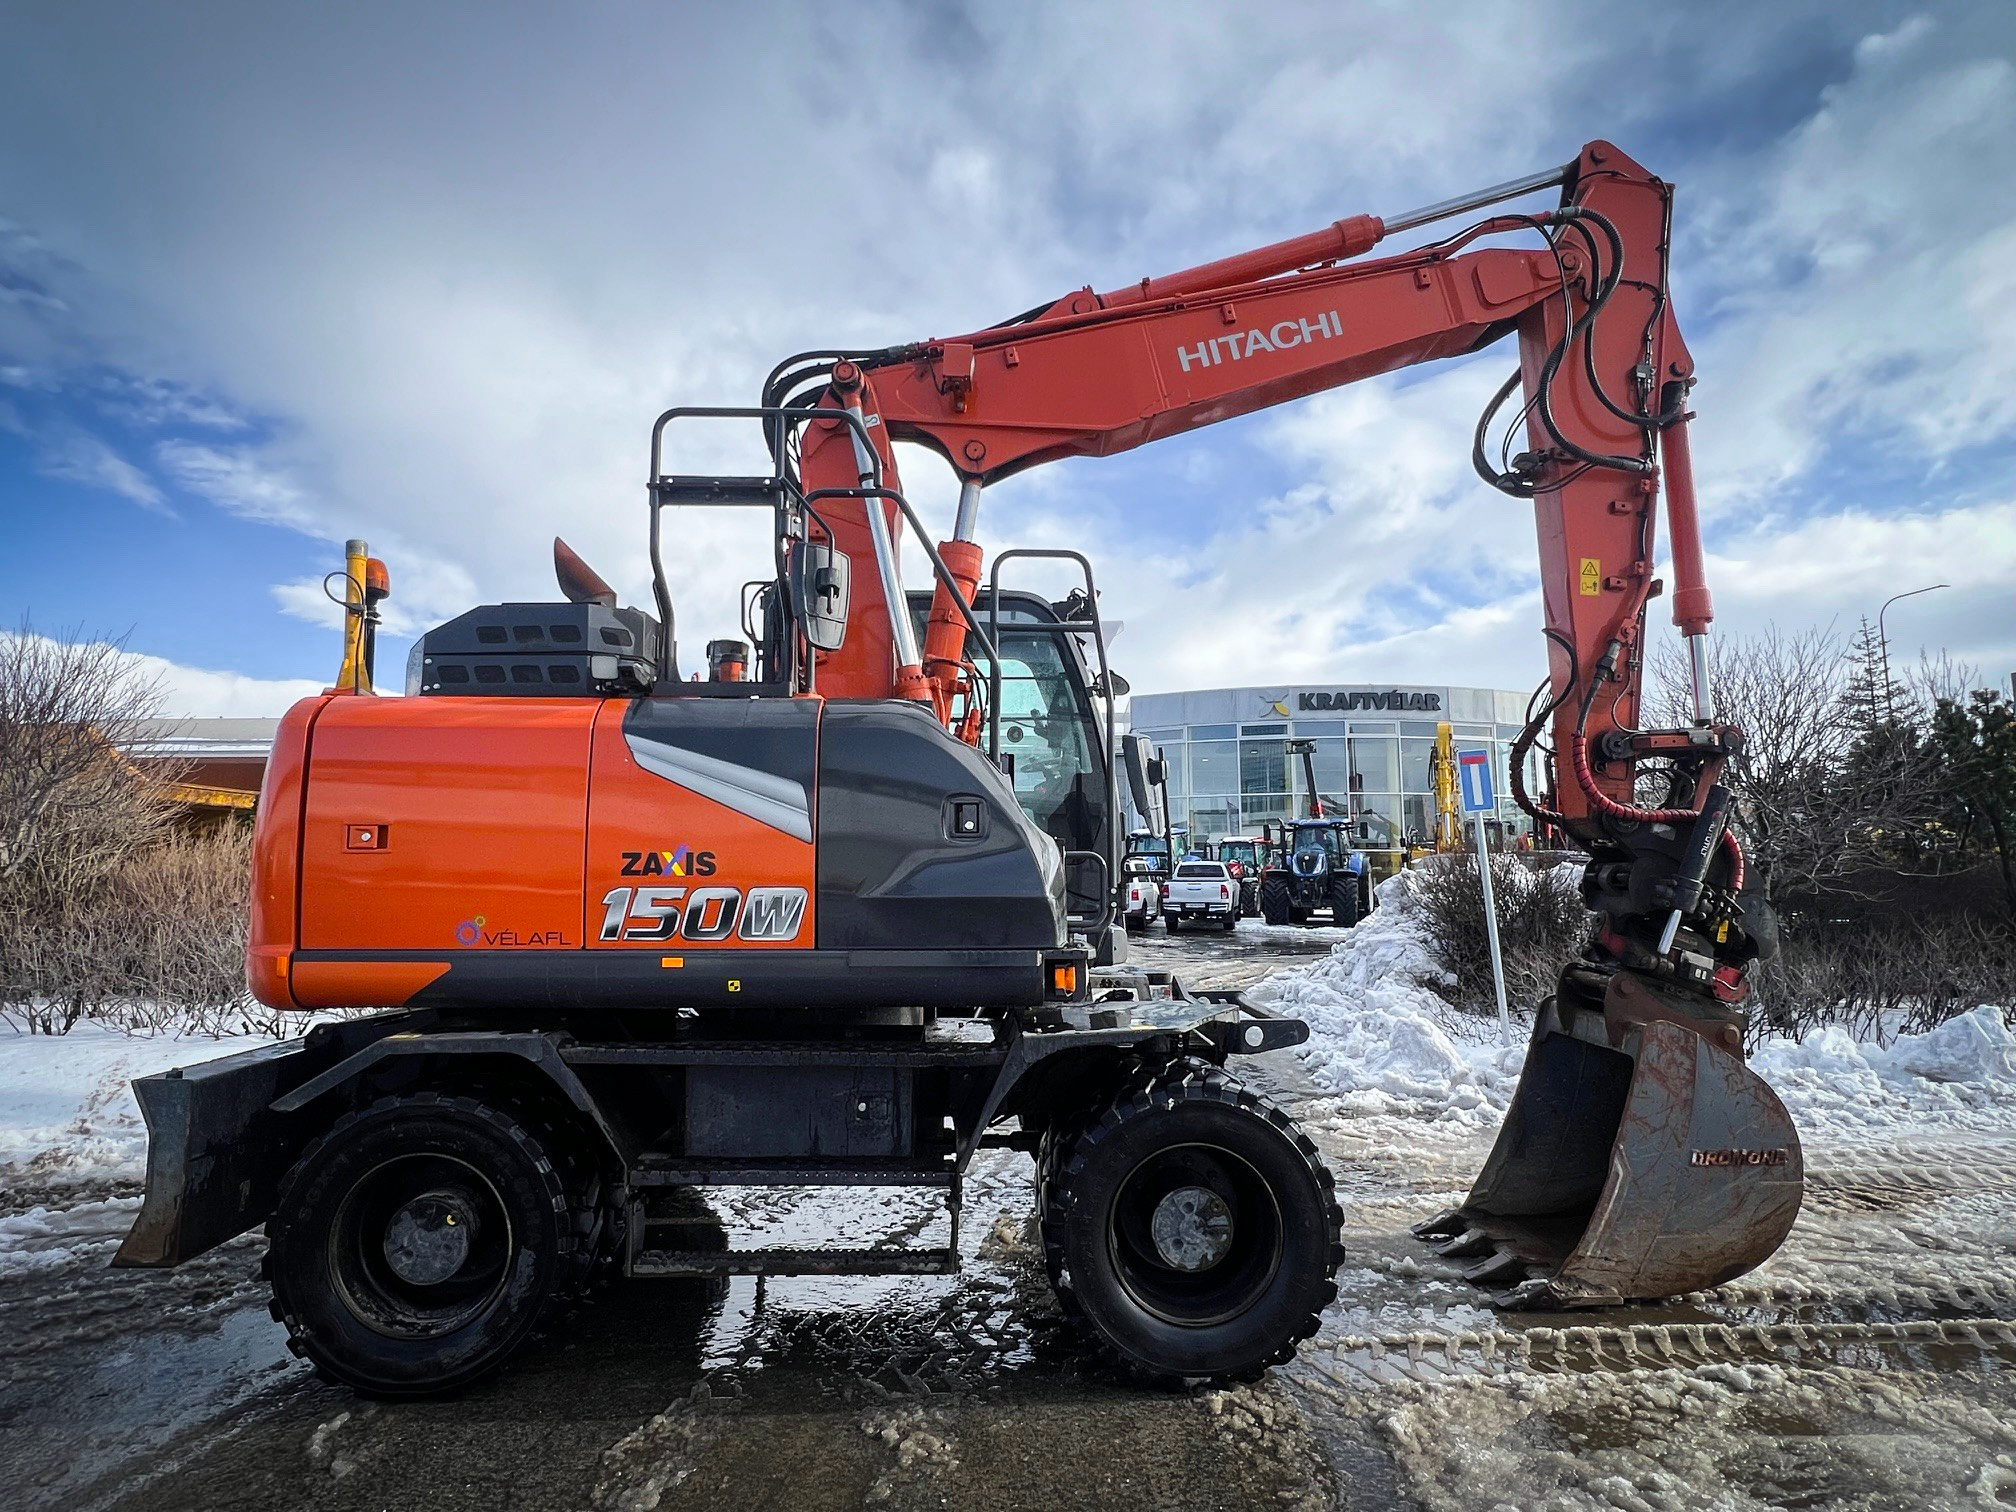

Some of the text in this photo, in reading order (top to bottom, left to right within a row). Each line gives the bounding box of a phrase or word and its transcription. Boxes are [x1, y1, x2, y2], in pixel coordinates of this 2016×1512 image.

[1176, 310, 1343, 372] HITACHI
[1298, 689, 1441, 711] KRAFTVÉLAR
[620, 844, 717, 877] ZAXIS
[599, 886, 810, 942] 150W
[483, 929, 572, 946] VÉLAFL
